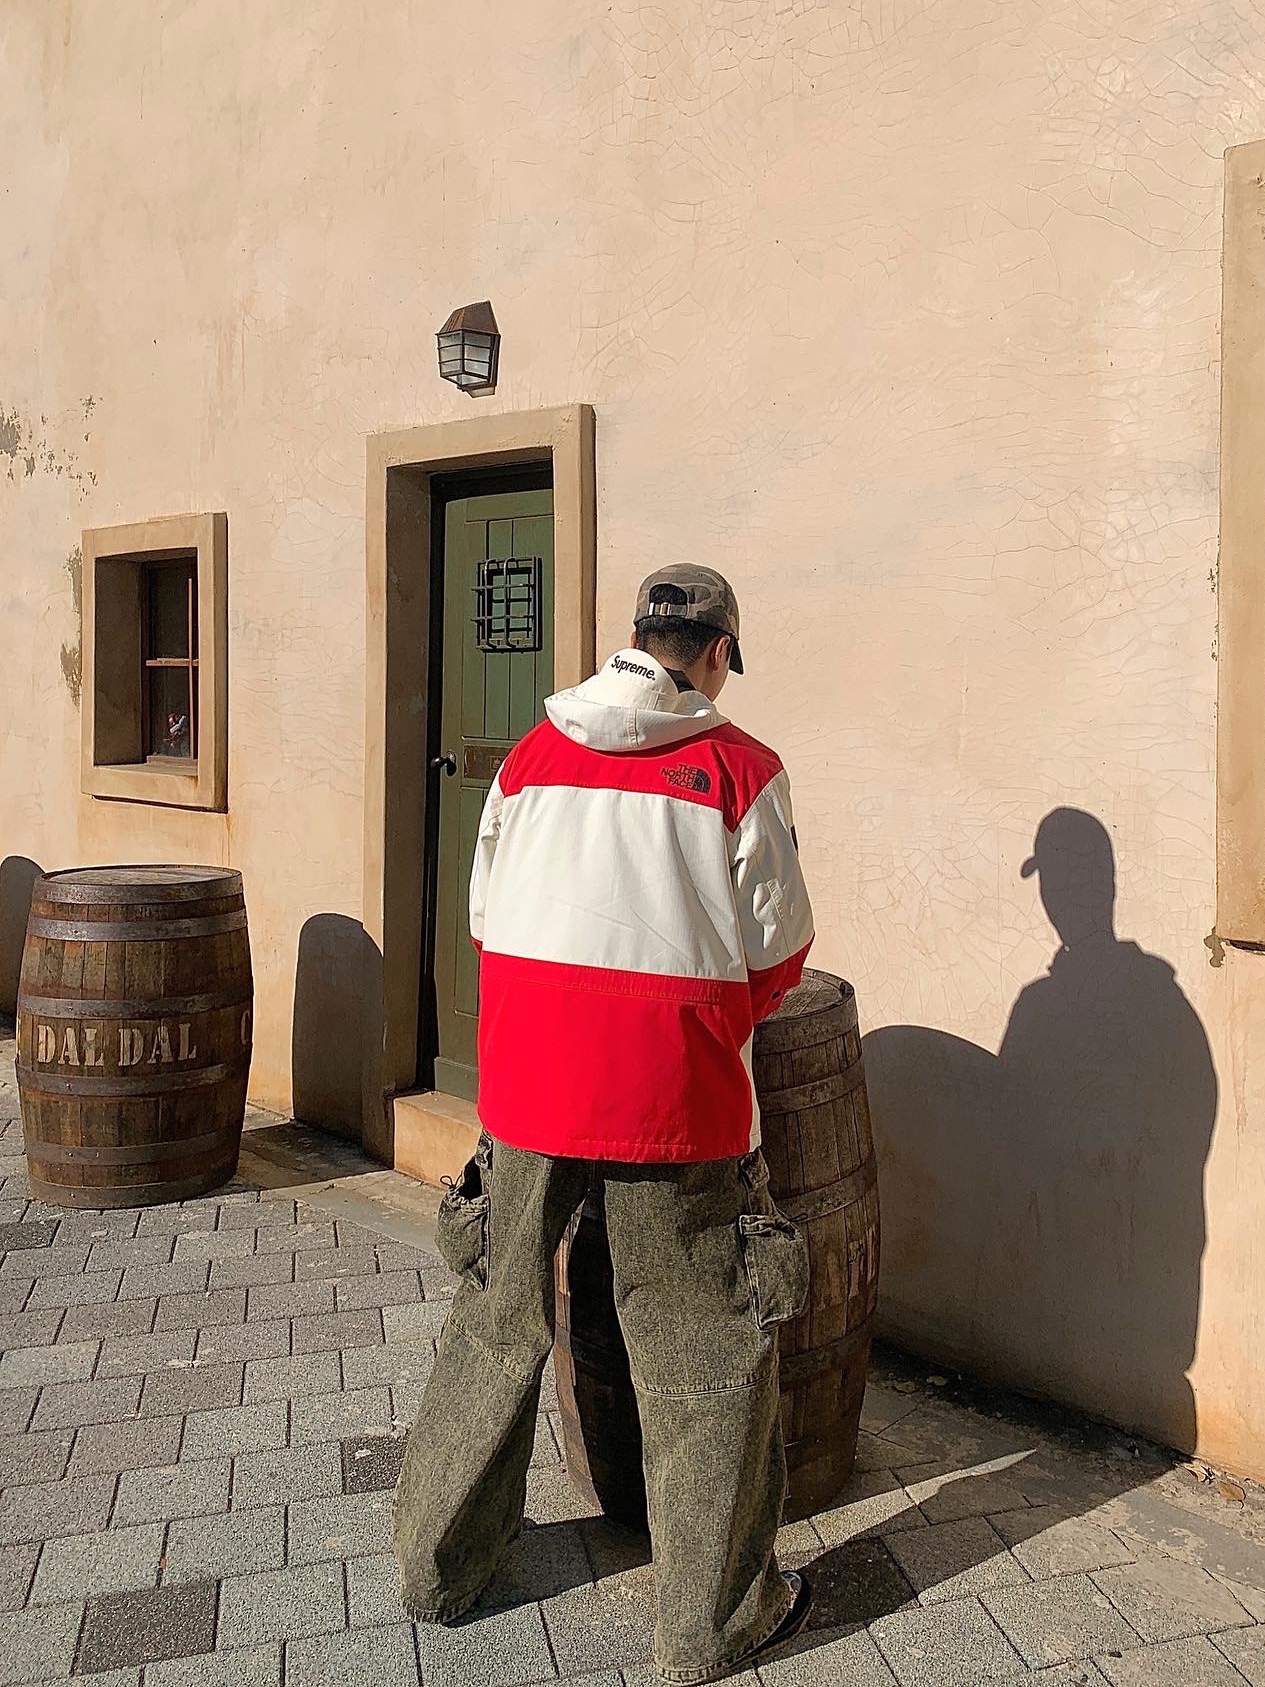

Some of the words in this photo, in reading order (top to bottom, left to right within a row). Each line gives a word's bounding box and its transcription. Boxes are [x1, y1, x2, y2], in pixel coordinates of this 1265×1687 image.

[660, 767, 695, 783] NORTH
[678, 763, 698, 776] THE
[667, 777, 694, 789] FACE
[37, 1024, 104, 1067] DAL
[118, 1022, 197, 1067] DAL
